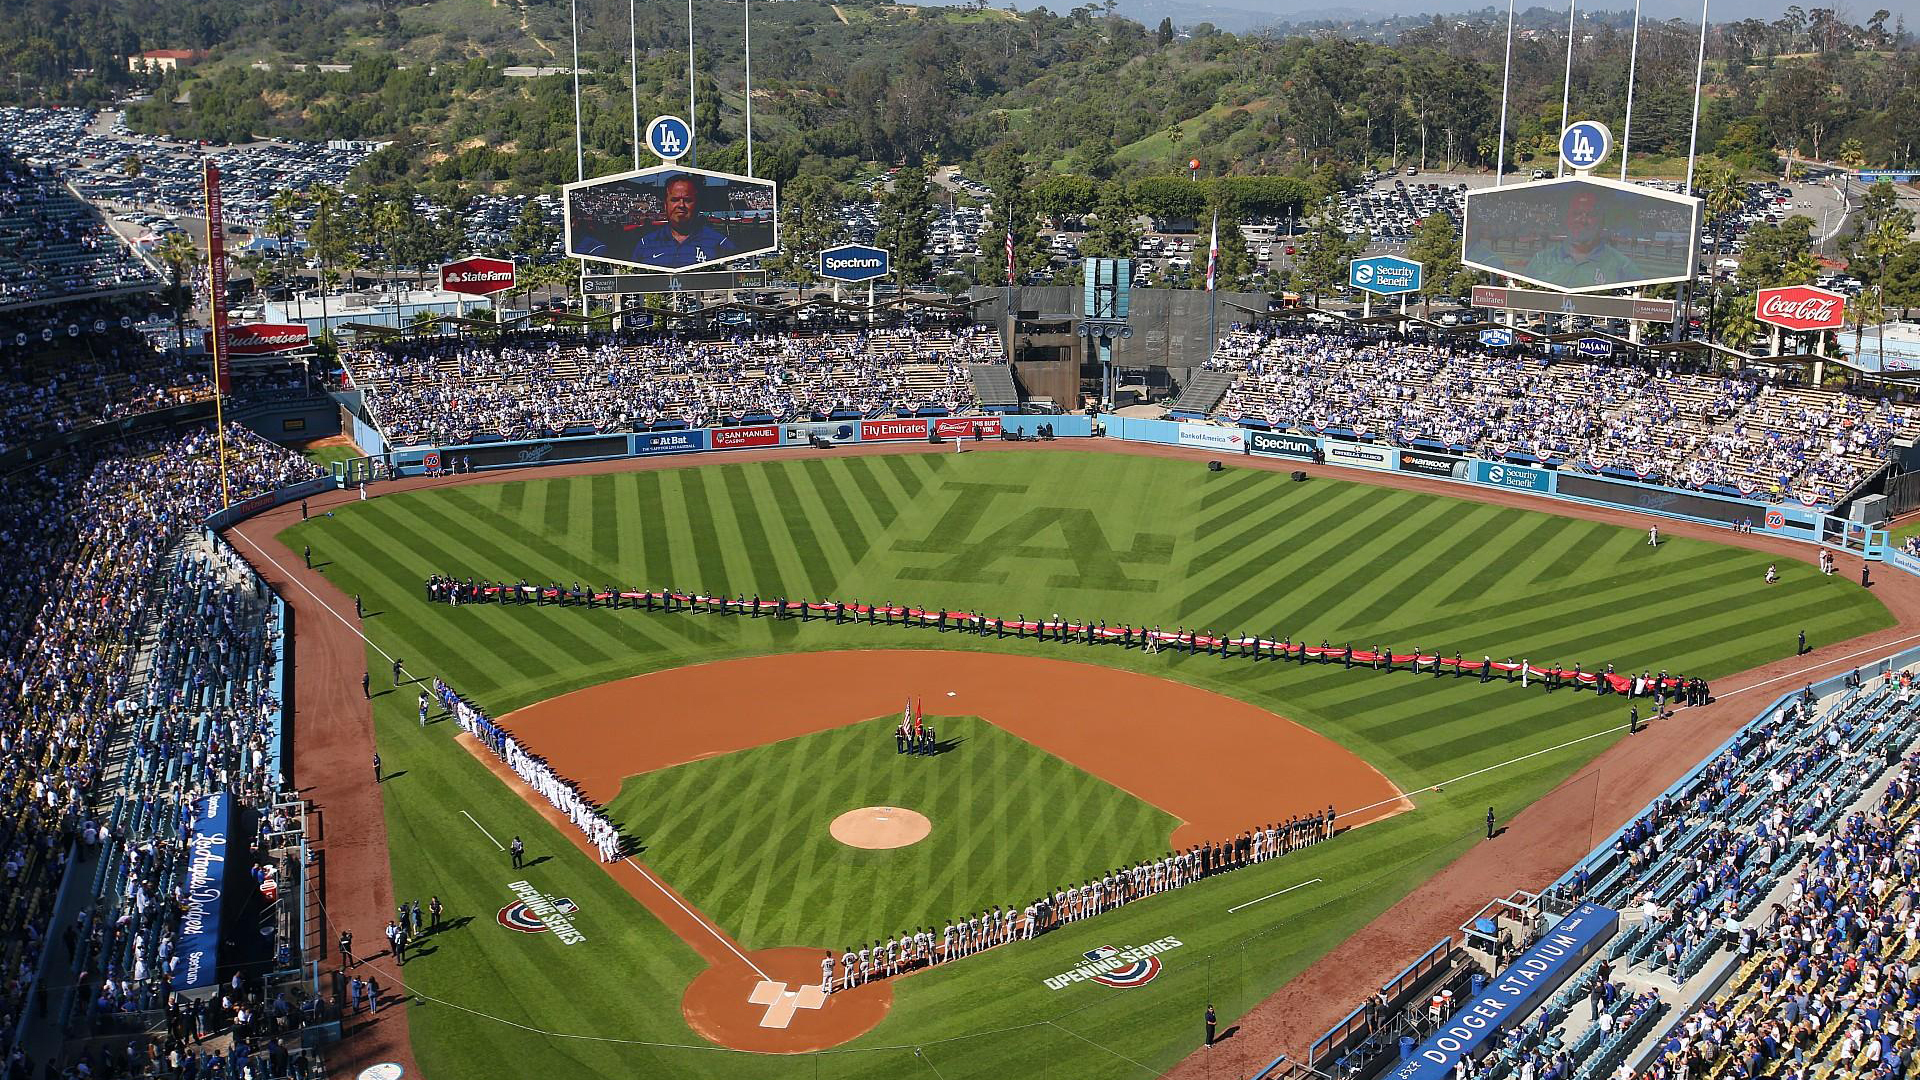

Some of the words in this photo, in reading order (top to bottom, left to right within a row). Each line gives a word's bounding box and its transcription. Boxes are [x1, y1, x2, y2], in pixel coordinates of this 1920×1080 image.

[660, 124, 681, 152] LA
[1572, 129, 1594, 161] LA
[210, 187, 221, 225] Emirates
[696, 247, 707, 263] LA
[826, 257, 880, 271] Spectrum
[1376, 265, 1415, 279] Security
[1376, 276, 1409, 287] Benefit
[1475, 295, 1504, 304] Emirates
[1481, 331, 1493, 340] JIM
[1580, 341, 1609, 352] DASANI
[724, 431, 741, 439] SAN
[742, 429, 775, 438] MANUEL
[863, 425, 880, 436] Fly
[881, 423, 926, 434] Emirates
[660, 437, 671, 446] At
[671, 436, 687, 445] Bat
[1254, 436, 1309, 453] Spectrum
[425, 455, 439, 466] 76
[1506, 467, 1538, 481] Security
[1506, 477, 1533, 488] Benefit
[1767, 514, 1783, 525] 76
[888, 481, 1177, 593] LA
[191, 832, 227, 850] Los
[187, 848, 225, 893] Angeles
[183, 887, 221, 935] Dodgers
[507, 880, 557, 916] OPENING
[540, 913, 587, 946] SERIES
[186, 951, 203, 985] Spectrum
[1043, 956, 1124, 991] OPENING
[1119, 935, 1184, 964] SERIES
[1422, 997, 1506, 1065] DODGER
[1499, 934, 1577, 996] STADIUM
